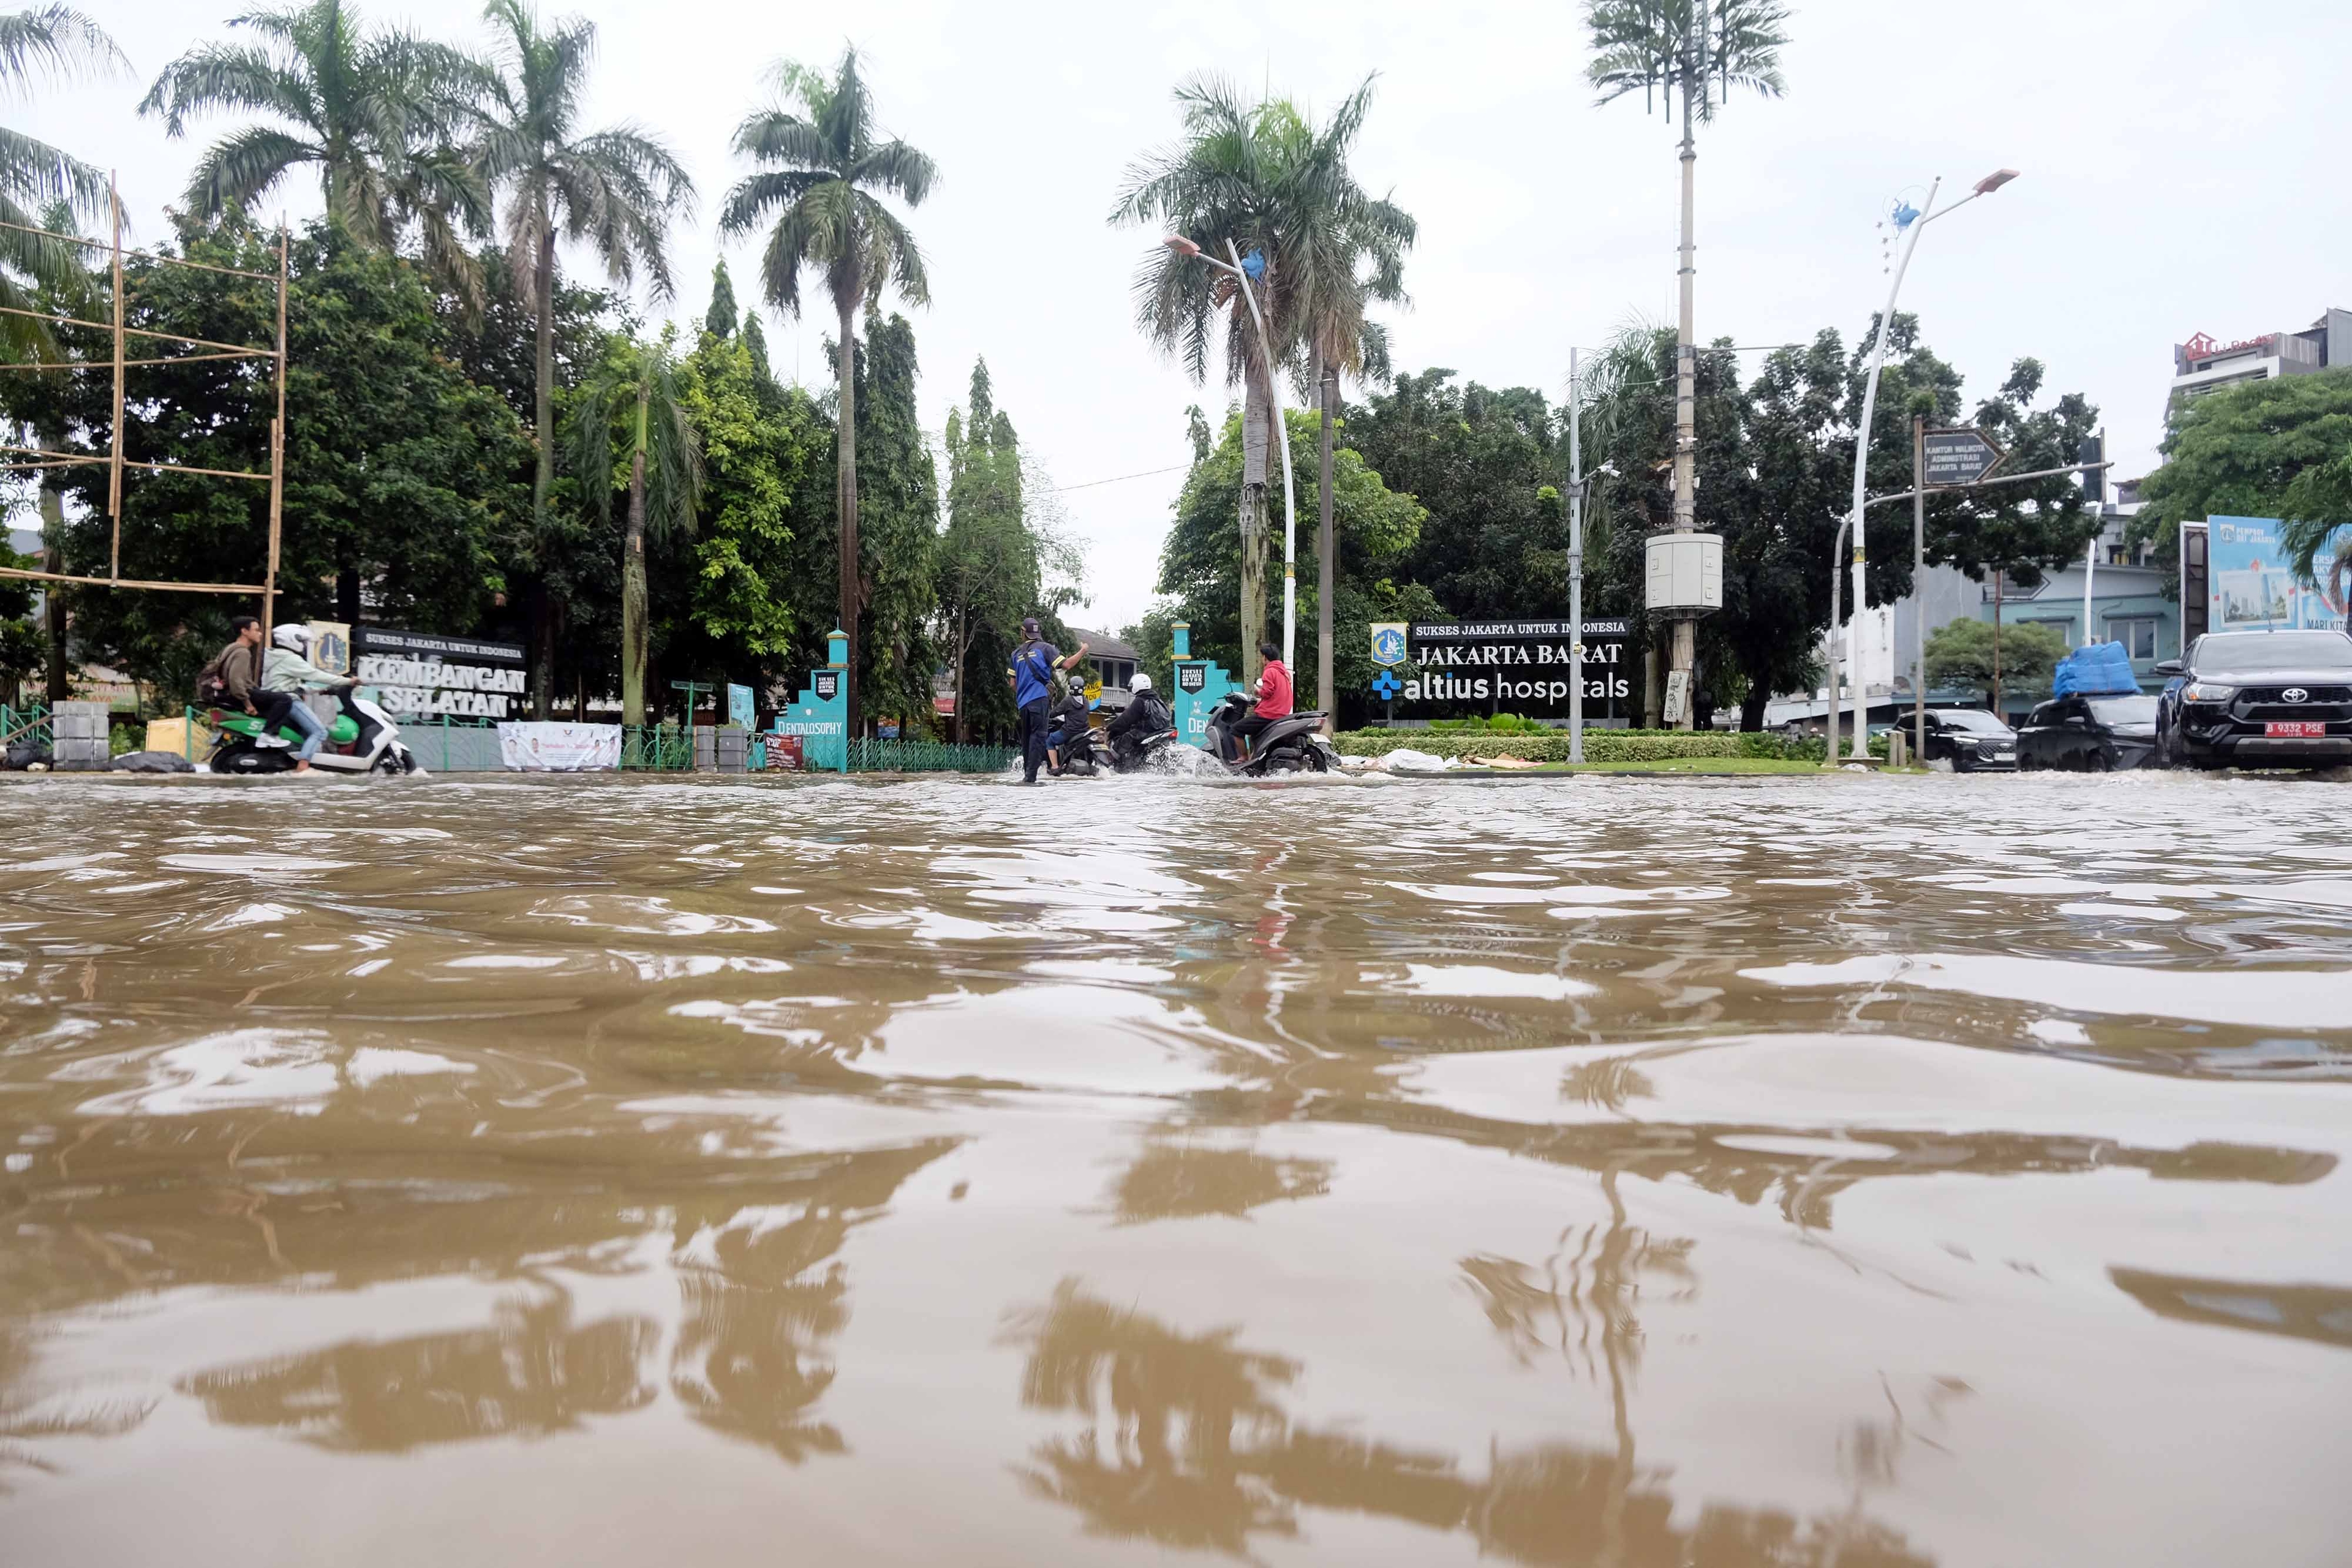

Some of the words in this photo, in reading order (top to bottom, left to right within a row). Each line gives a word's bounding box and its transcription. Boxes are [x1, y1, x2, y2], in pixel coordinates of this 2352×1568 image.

[1927, 445, 1953, 454] KANTOR
[1932, 454, 1980, 463] ADMINISTRASI
[1928, 463, 1958, 472] JAKARTA
[1415, 625, 1460, 636] SUKSES
[1461, 624, 1515, 636] JAKARTA
[1518, 623, 1558, 634] UNTUK
[1561, 622, 1626, 633] INONESIA
[2307, 619, 2328, 630] MARI
[366, 633, 404, 645] SUKSES
[405, 638, 447, 650] JAKARTA
[448, 643, 478, 654] UNTUK
[478, 646, 522, 659] INDONESIA
[1417, 646, 1531, 666] JAKARTA
[1536, 644, 1623, 665] BARAT
[358, 656, 526, 693] KEMBANGAN
[1404, 672, 1490, 700] altius
[1497, 672, 1629, 706] hosptals
[381, 686, 509, 718] SELATAN
[2266, 724, 2273, 733] B
[2278, 724, 2301, 733] 9332
[2305, 724, 2323, 733] PSE
